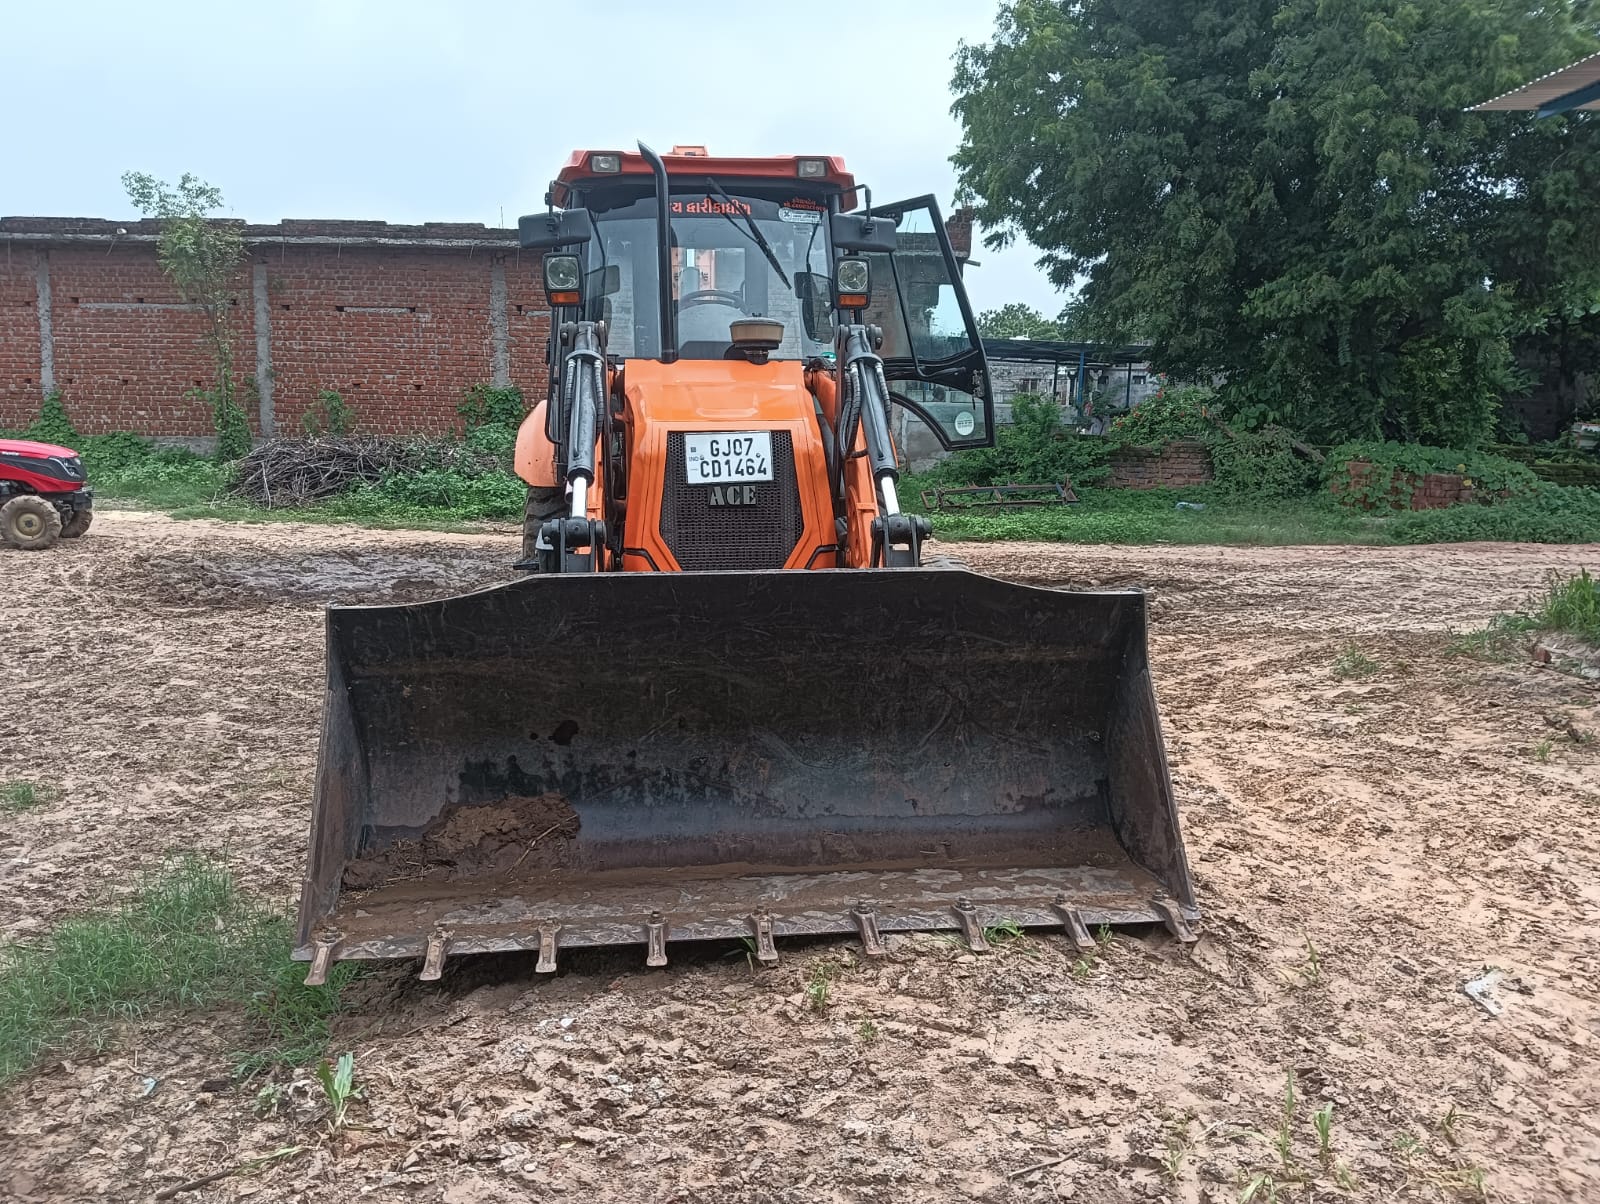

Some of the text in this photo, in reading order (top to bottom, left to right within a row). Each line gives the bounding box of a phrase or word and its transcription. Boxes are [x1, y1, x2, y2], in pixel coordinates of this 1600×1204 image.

[710, 438, 753, 457] GJ07
[700, 458, 767, 478] CD1464
[709, 486, 756, 506] ACE
